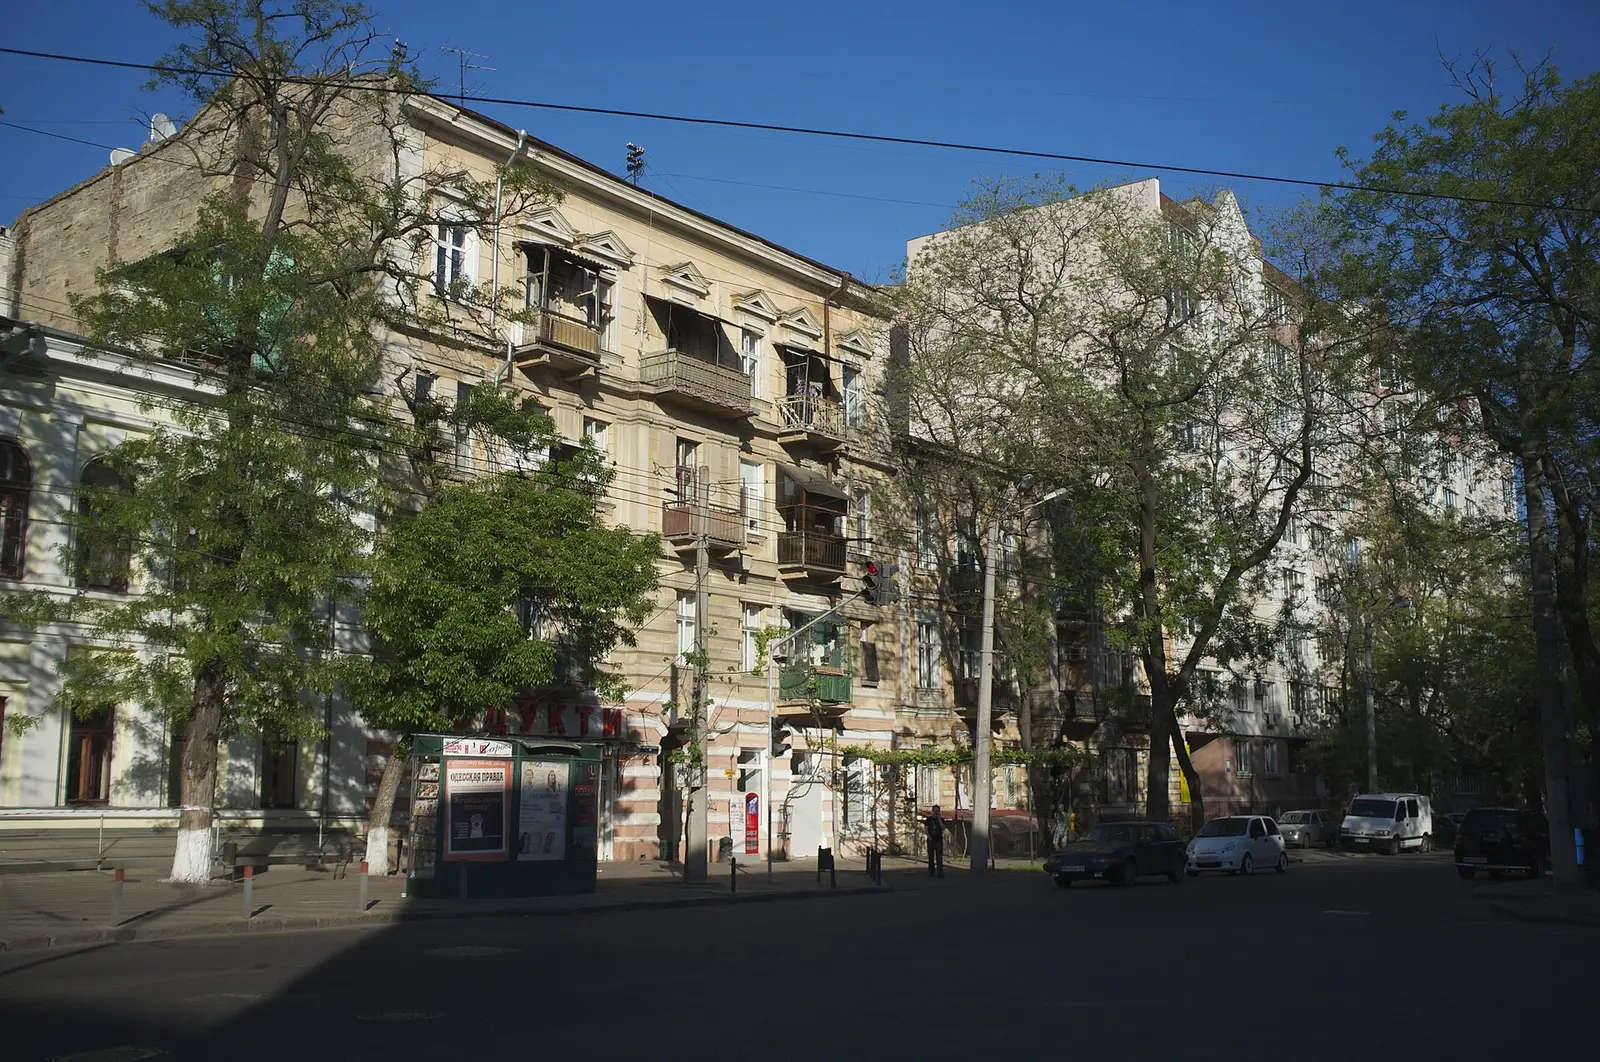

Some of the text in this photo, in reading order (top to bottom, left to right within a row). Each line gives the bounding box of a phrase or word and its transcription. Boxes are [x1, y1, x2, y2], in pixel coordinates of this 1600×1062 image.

[453, 702, 622, 737] ДУКТИ
[451, 772, 503, 783] ОДЕССКАЯ ПРАВДА
